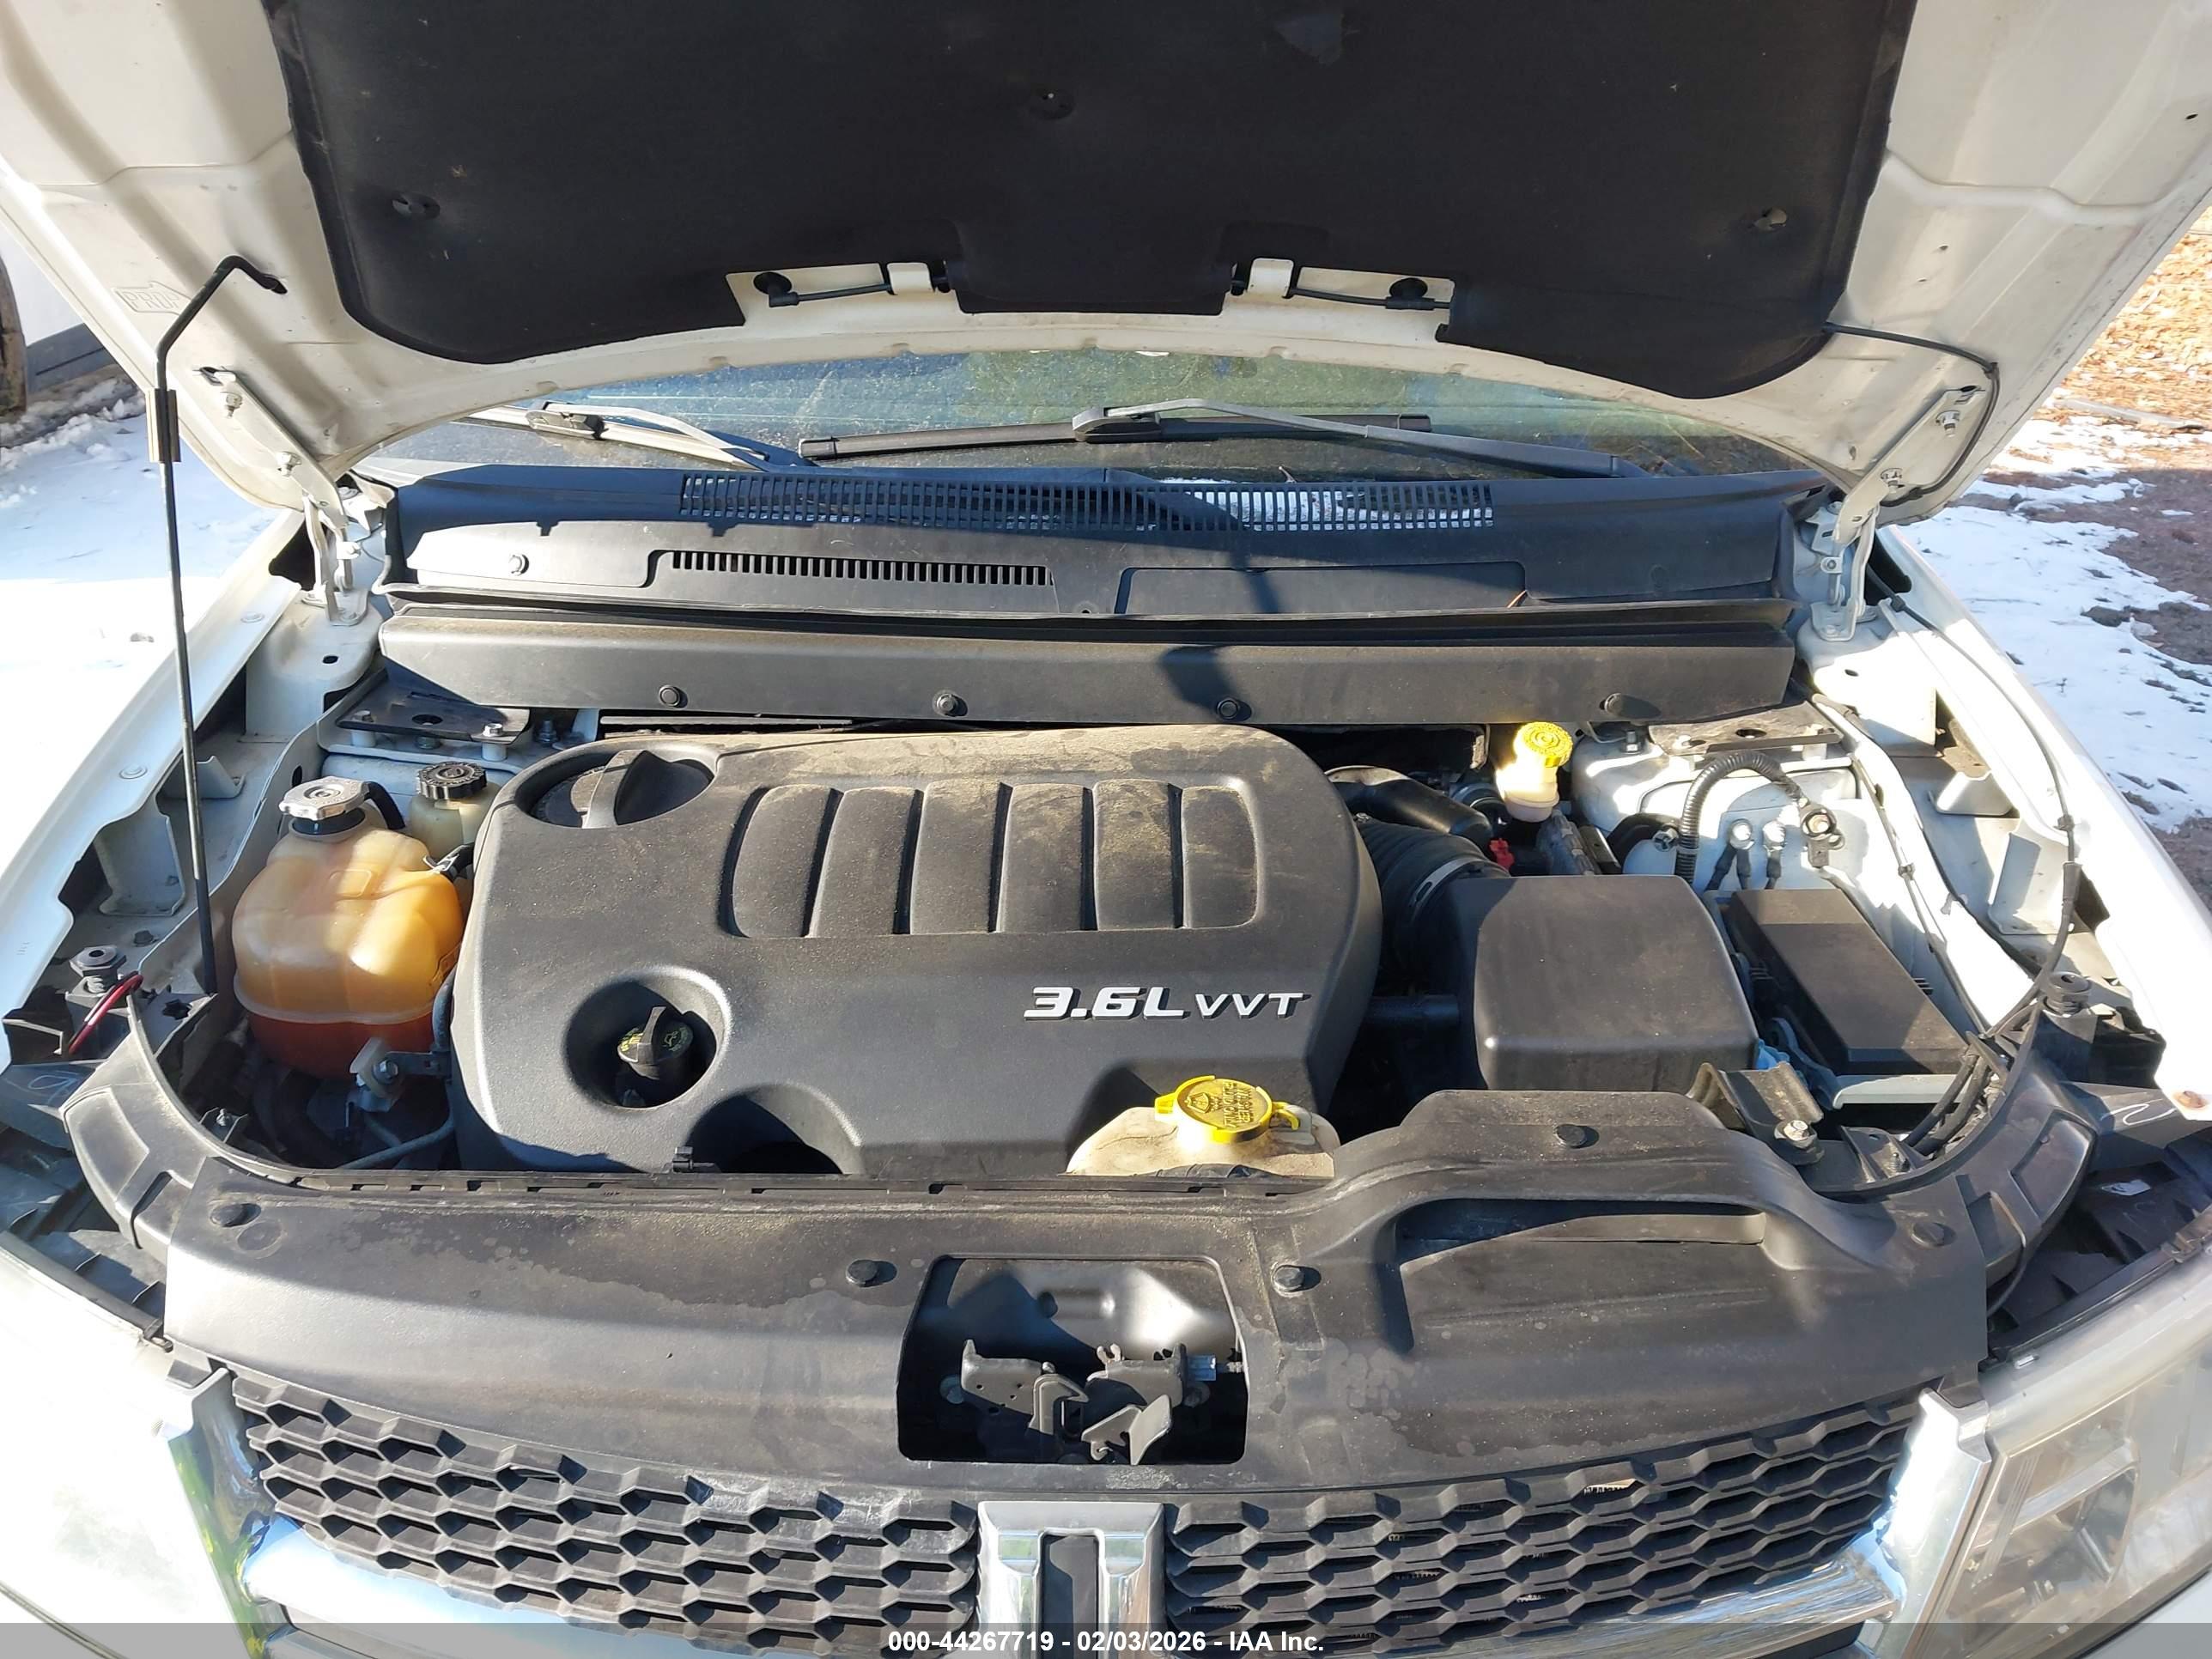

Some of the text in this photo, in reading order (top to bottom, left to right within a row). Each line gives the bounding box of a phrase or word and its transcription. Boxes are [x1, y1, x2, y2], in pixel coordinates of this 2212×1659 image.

[1024, 987, 1305, 1019] 3.6L VVT
[1222, 1080, 1237, 1127] FLUID ONLY
[1237, 1087, 1253, 1123] WASHER
